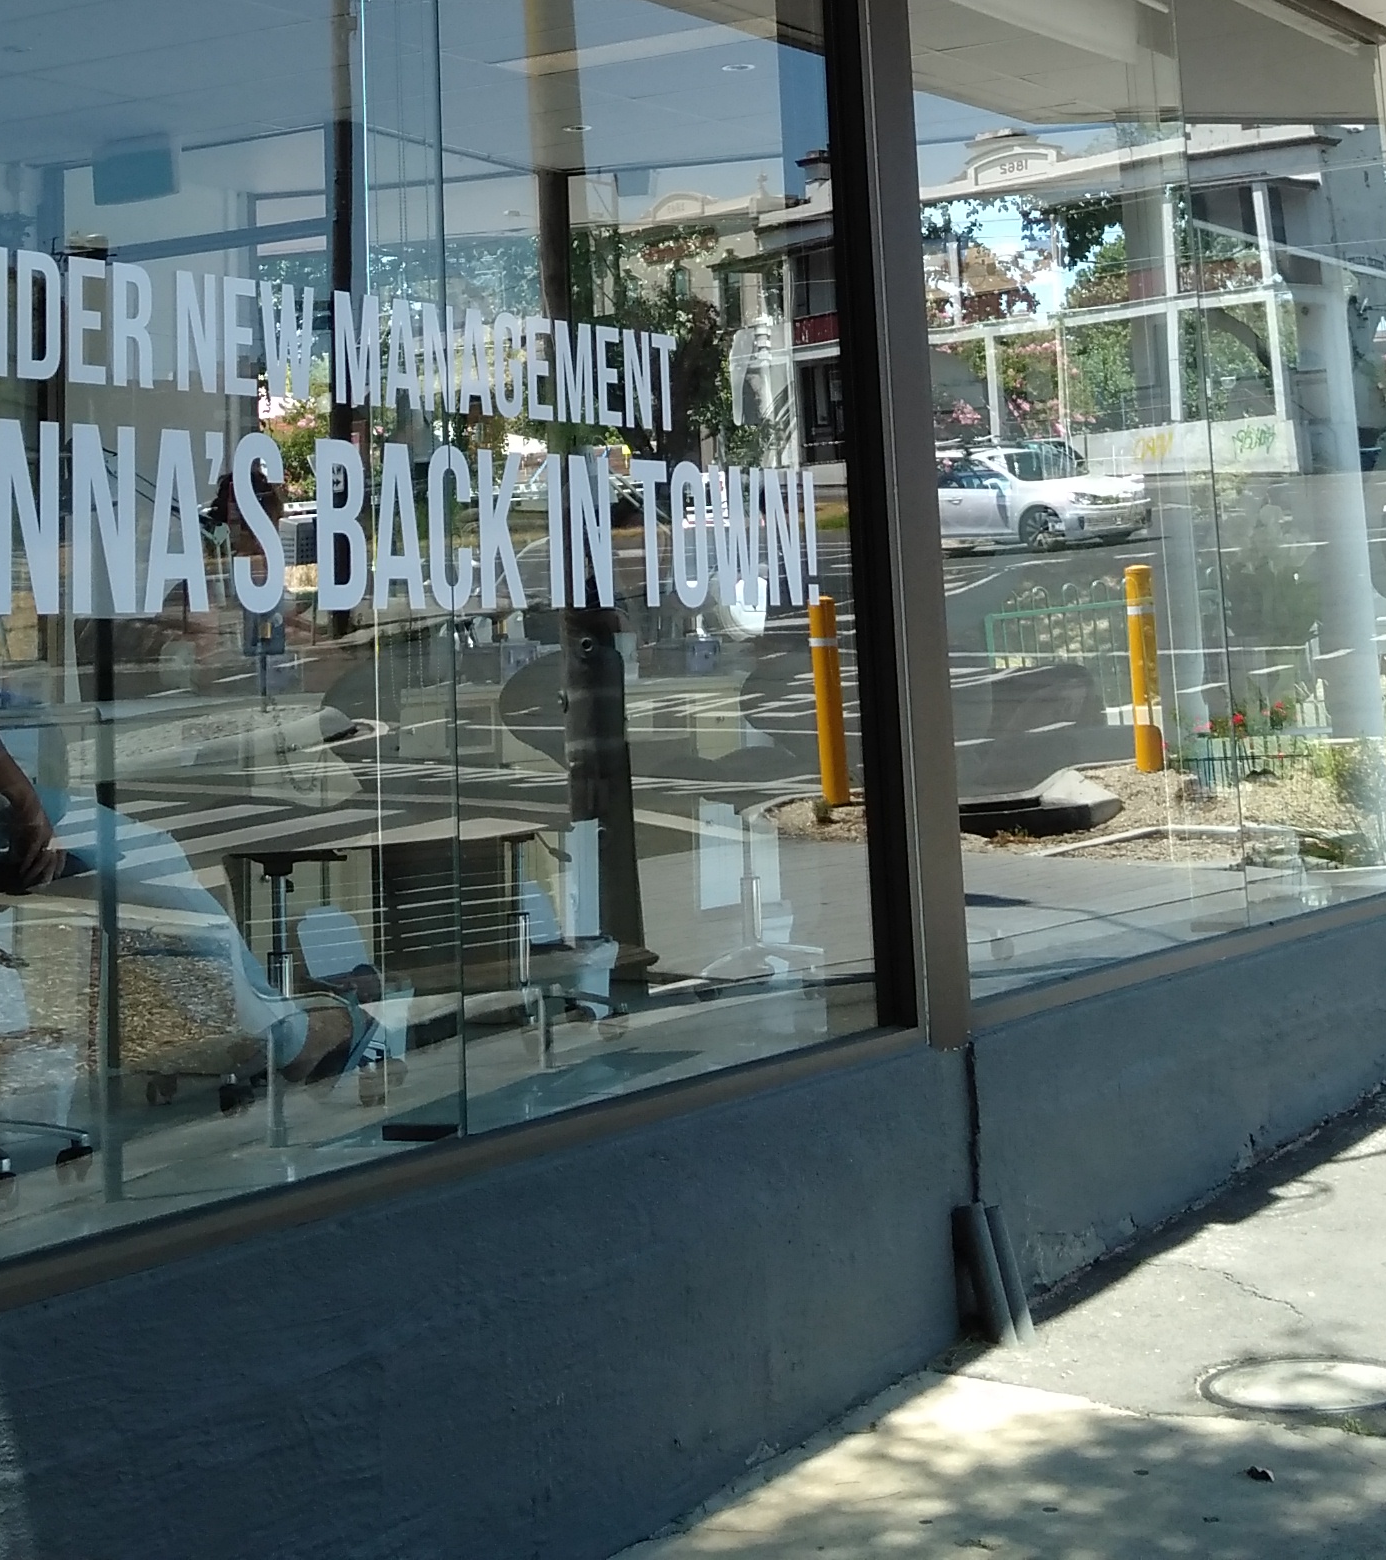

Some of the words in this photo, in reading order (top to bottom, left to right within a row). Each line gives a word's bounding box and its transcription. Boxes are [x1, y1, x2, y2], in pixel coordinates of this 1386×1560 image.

[176, 270, 315, 397] NEW
[335, 291, 676, 431] MANAGEMENT
[315, 439, 527, 612] BACK
[548, 453, 614, 609] IN
[629, 459, 820, 608] TOWN!
